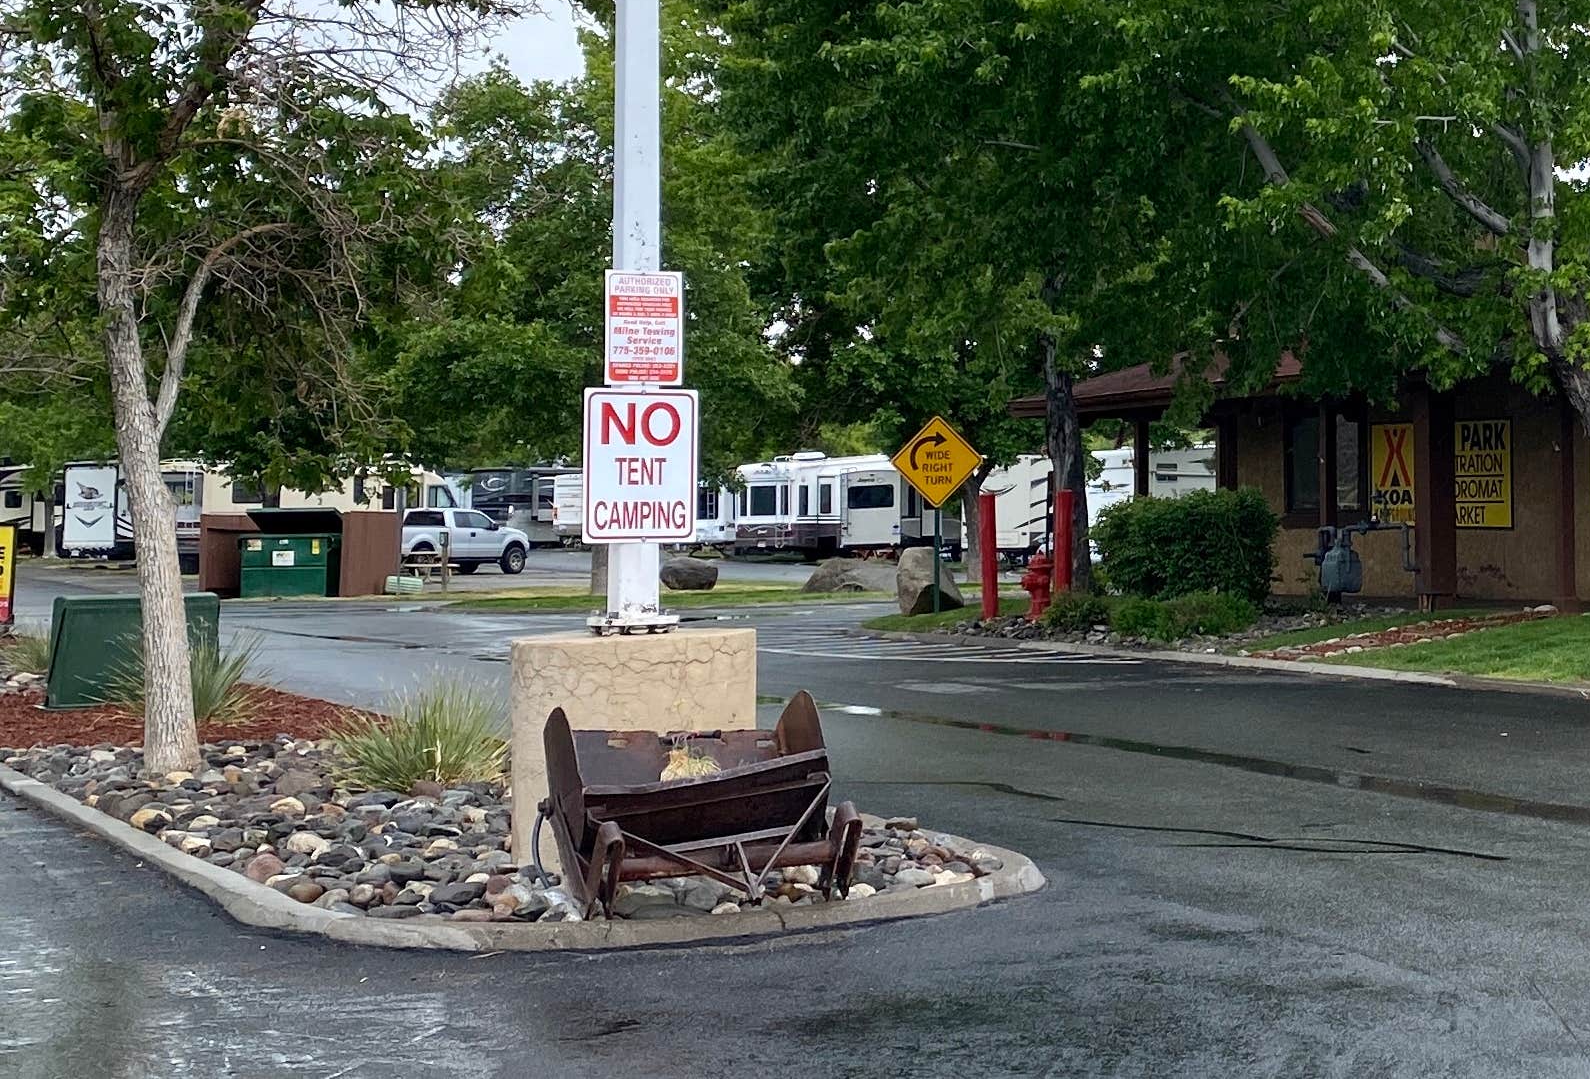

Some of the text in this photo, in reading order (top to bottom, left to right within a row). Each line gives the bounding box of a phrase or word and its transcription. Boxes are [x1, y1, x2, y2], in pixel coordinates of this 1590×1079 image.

[618, 276, 671, 286] AUTHORIZED
[614, 285, 674, 295] PARKING ONLY
[613, 326, 675, 337] Milne Towing
[627, 336, 662, 345] Service
[601, 401, 681, 446] NO
[1461, 422, 1506, 451] PARK
[925, 450, 951, 460] WIDE
[614, 457, 667, 486] TENT
[922, 463, 953, 472] RIGHT
[925, 475, 953, 485] TURN
[594, 500, 687, 530] CAMPING
